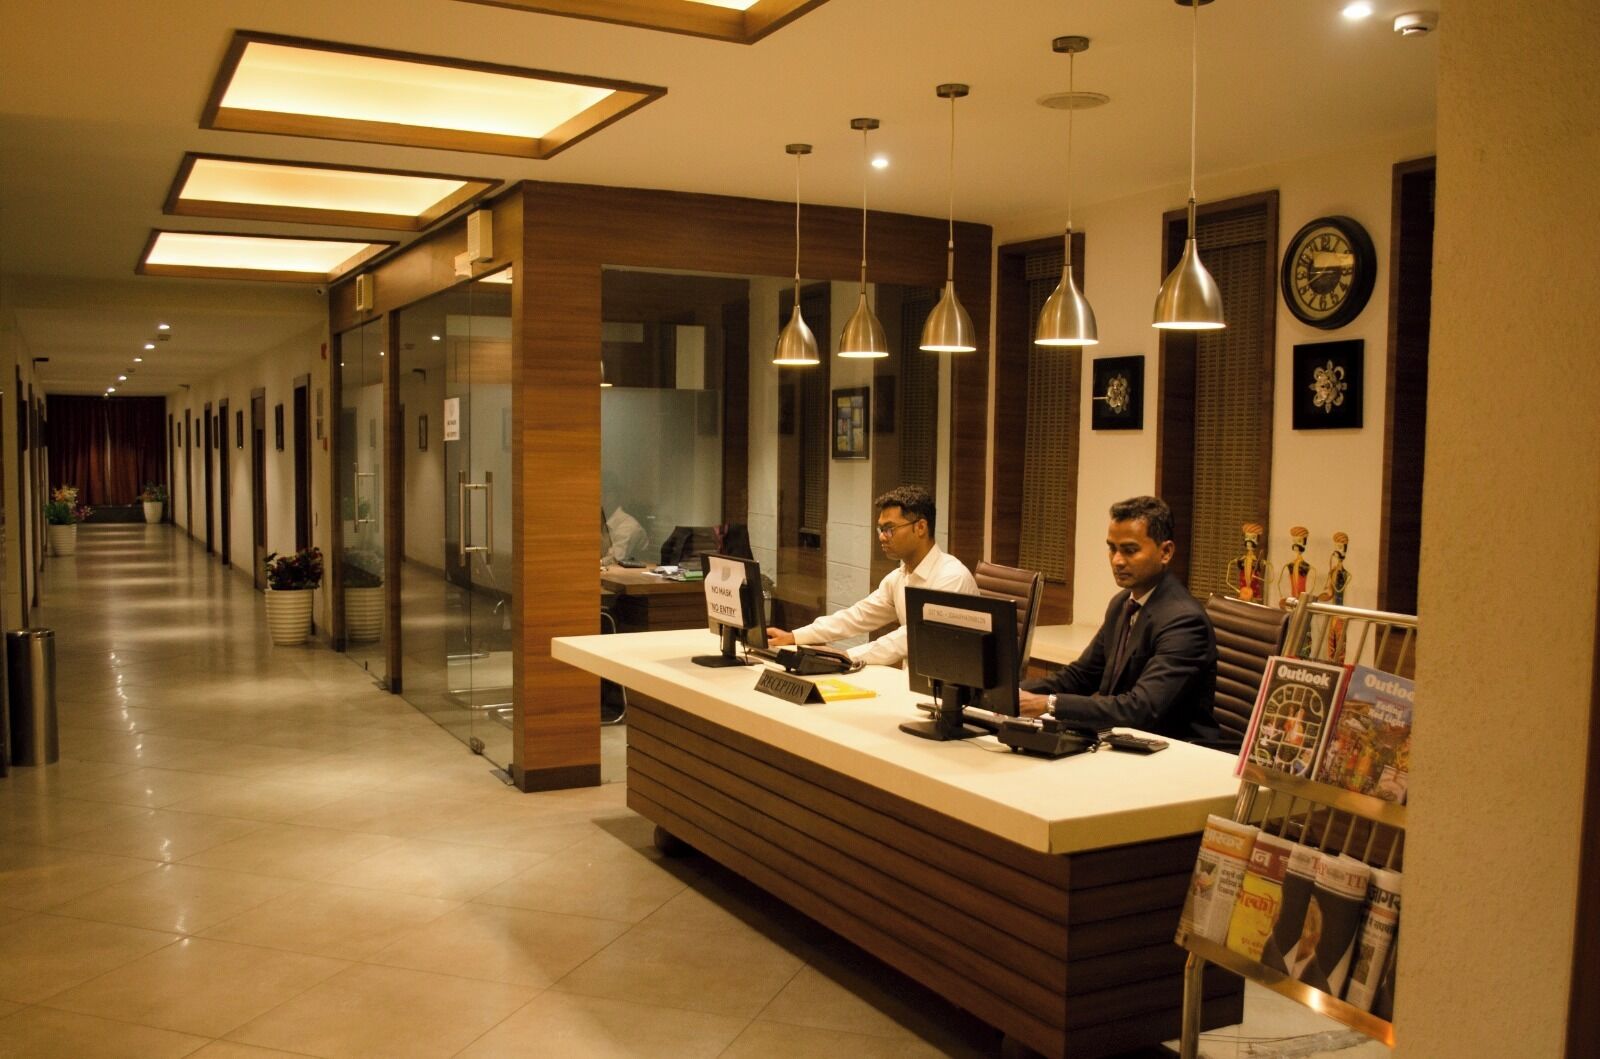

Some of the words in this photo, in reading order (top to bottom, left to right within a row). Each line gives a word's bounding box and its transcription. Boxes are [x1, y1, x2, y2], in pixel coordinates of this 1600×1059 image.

[711, 585, 719, 594] NO
[761, 674, 807, 698] RECEPTION
[1277, 664, 1331, 688] Outlook
